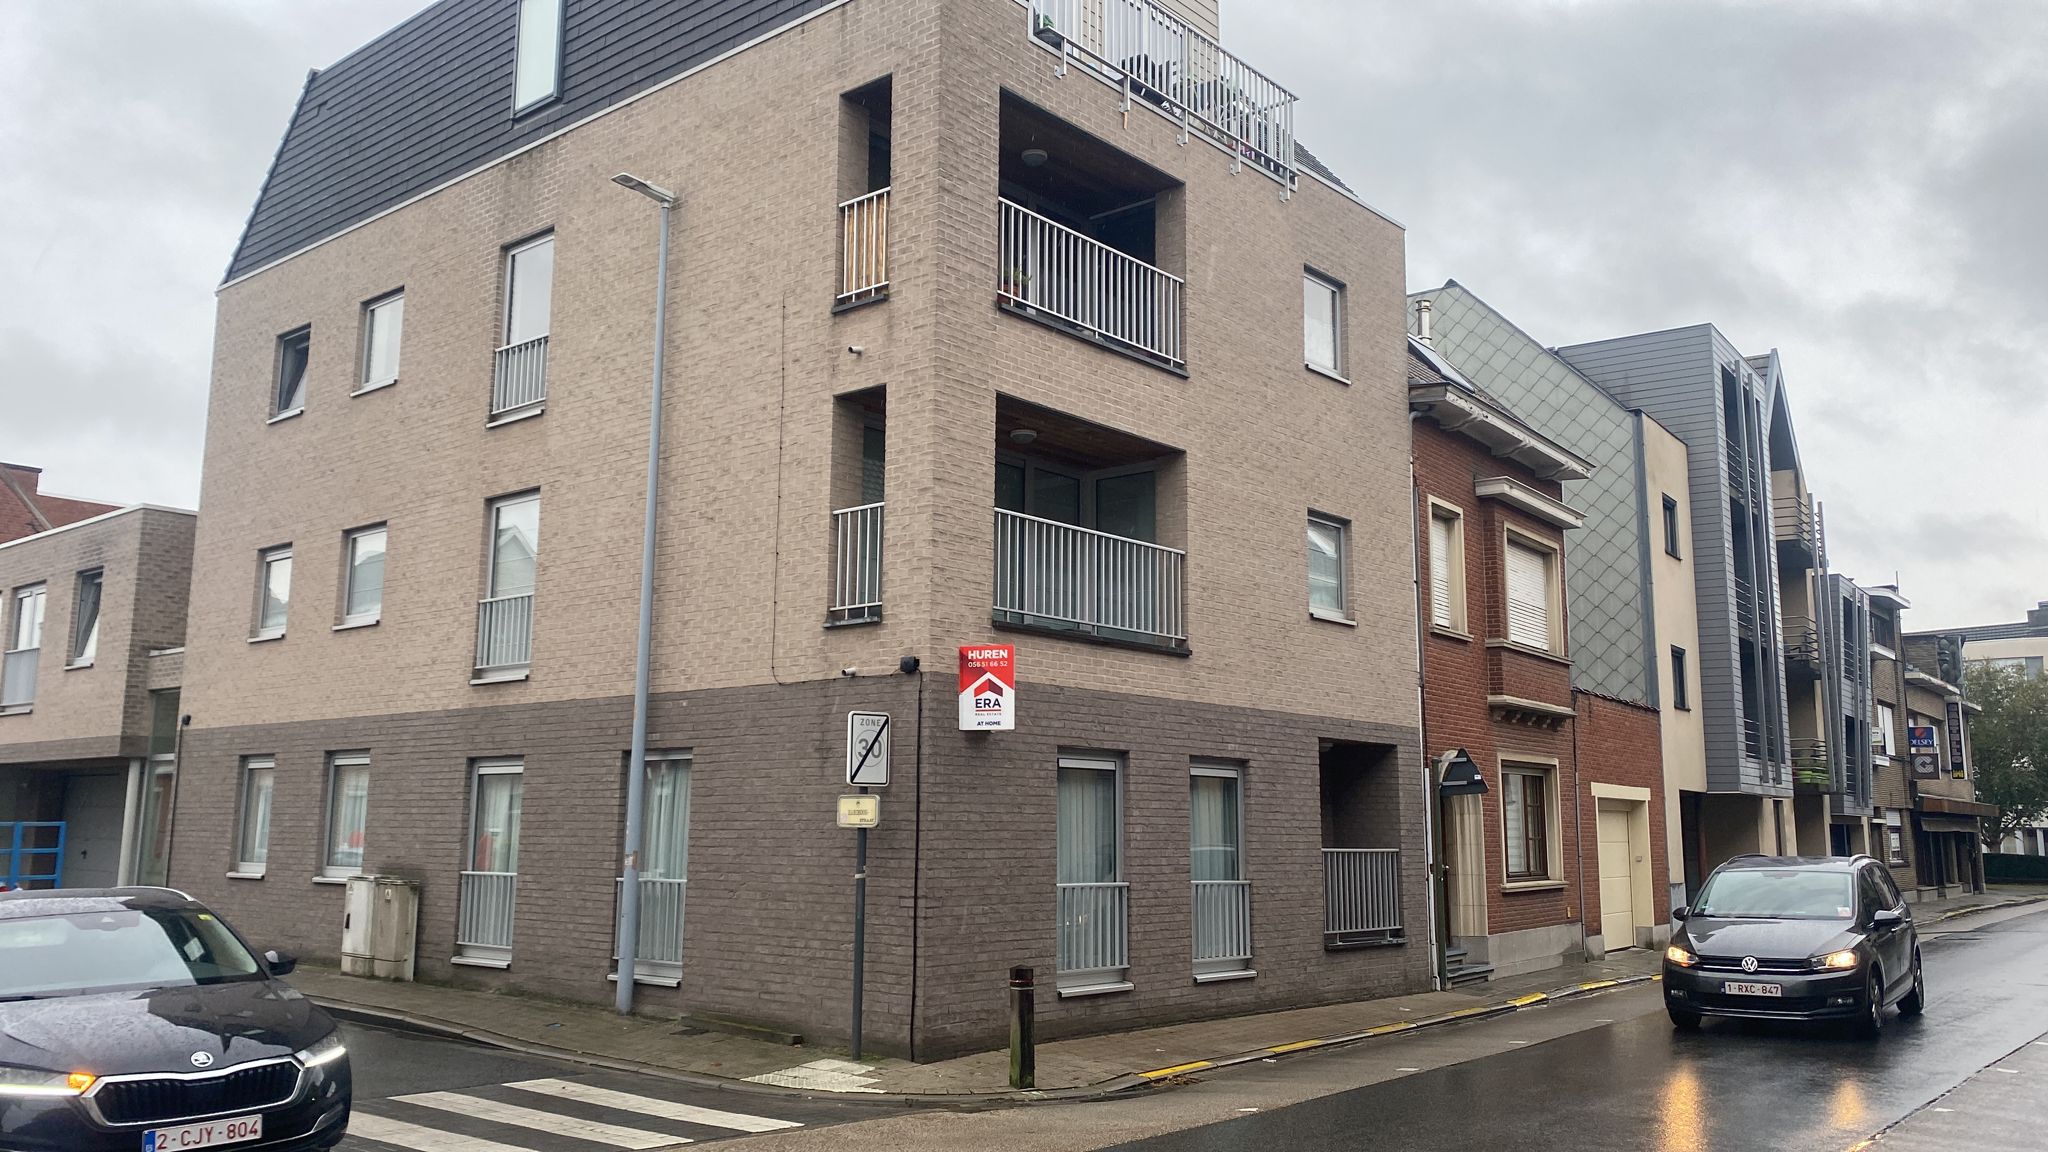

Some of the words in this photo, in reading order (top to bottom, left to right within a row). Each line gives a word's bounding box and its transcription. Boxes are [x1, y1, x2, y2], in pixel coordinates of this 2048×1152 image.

[968, 649, 1008, 660] HUREN
[975, 698, 1002, 709] ERA
[860, 718, 881, 727] ZONE
[857, 737, 882, 759] 30
[1727, 983, 1779, 995] 1-RXC-847
[156, 1119, 259, 1151] 2-CJY-804
